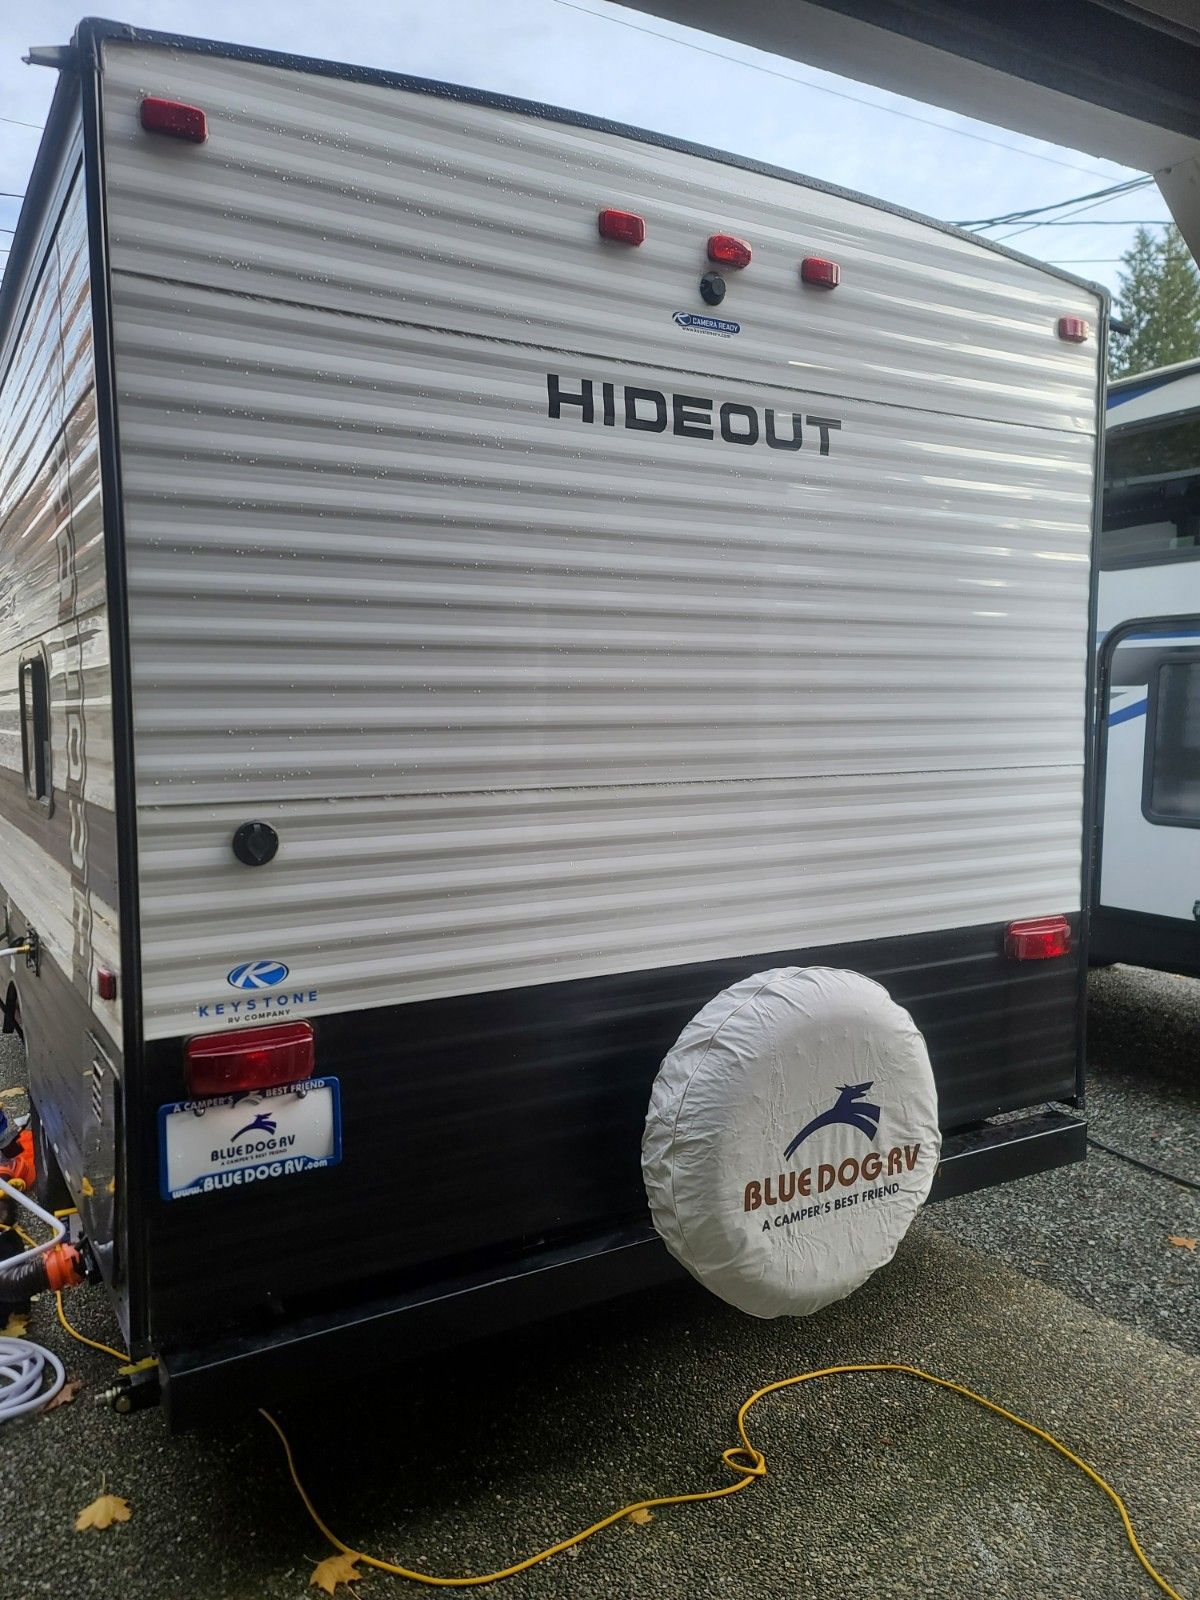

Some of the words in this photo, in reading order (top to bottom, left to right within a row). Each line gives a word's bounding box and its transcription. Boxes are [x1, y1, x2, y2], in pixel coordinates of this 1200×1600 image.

[692, 317, 717, 329] CAMERA
[718, 322, 739, 332] READY
[547, 373, 841, 456] HIDEOUT
[199, 990, 318, 1017] KEYSTONE
[228, 1016, 241, 1024] RV
[244, 1009, 291, 1021] COMPANY
[173, 1104, 181, 1113] A
[184, 1095, 234, 1112] CAMPER'S
[265, 1086, 288, 1097] BEST
[290, 1080, 325, 1093] FRIEND
[279, 1134, 296, 1148] RV
[743, 1167, 812, 1212] BLUE
[817, 1152, 883, 1194] DOG
[887, 1143, 921, 1177] RV
[762, 1219, 771, 1232] A
[774, 1200, 831, 1228] CAMPER'S
[834, 1193, 859, 1210] BEST
[862, 1182, 900, 1203] FRIEND
